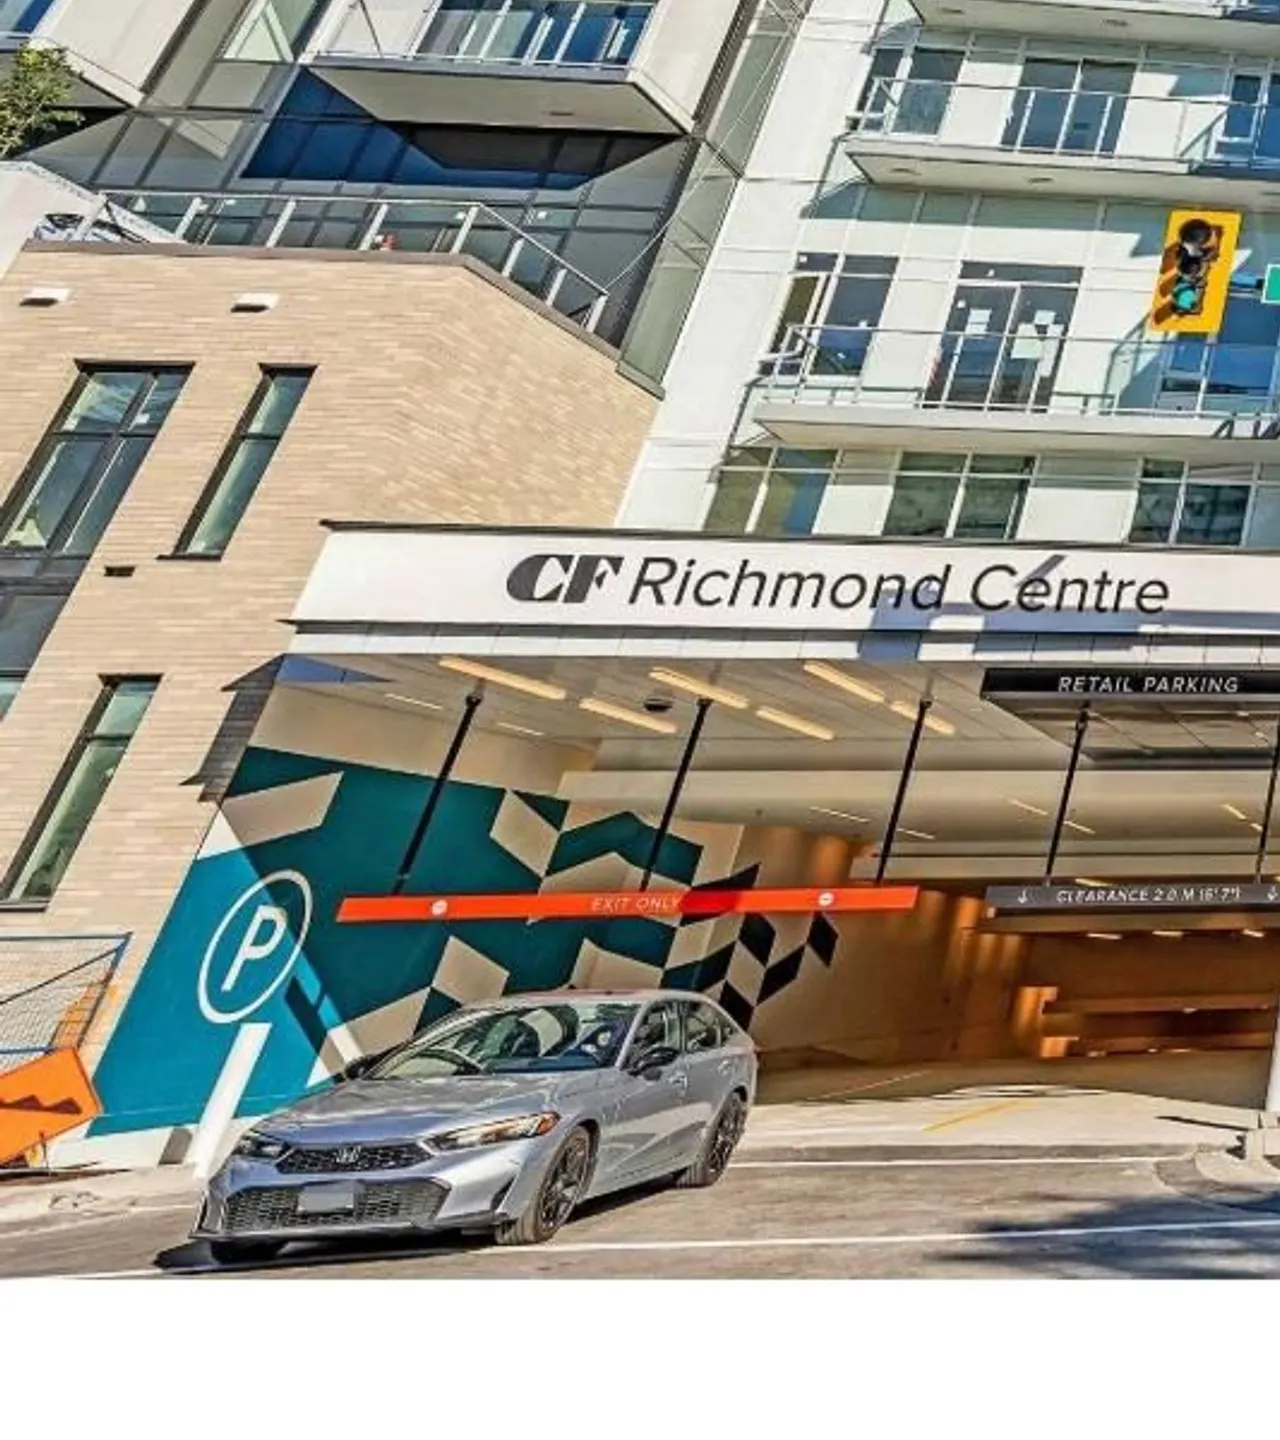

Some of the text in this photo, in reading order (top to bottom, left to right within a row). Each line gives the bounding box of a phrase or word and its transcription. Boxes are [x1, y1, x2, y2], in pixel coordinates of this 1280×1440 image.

[506, 554, 1170, 613] CF Richmond Centre
[1057, 675, 1239, 693] RETAIL PARKING
[591, 894, 682, 913] EXIT ONLY
[1056, 889, 1149, 903] CLEARANCE
